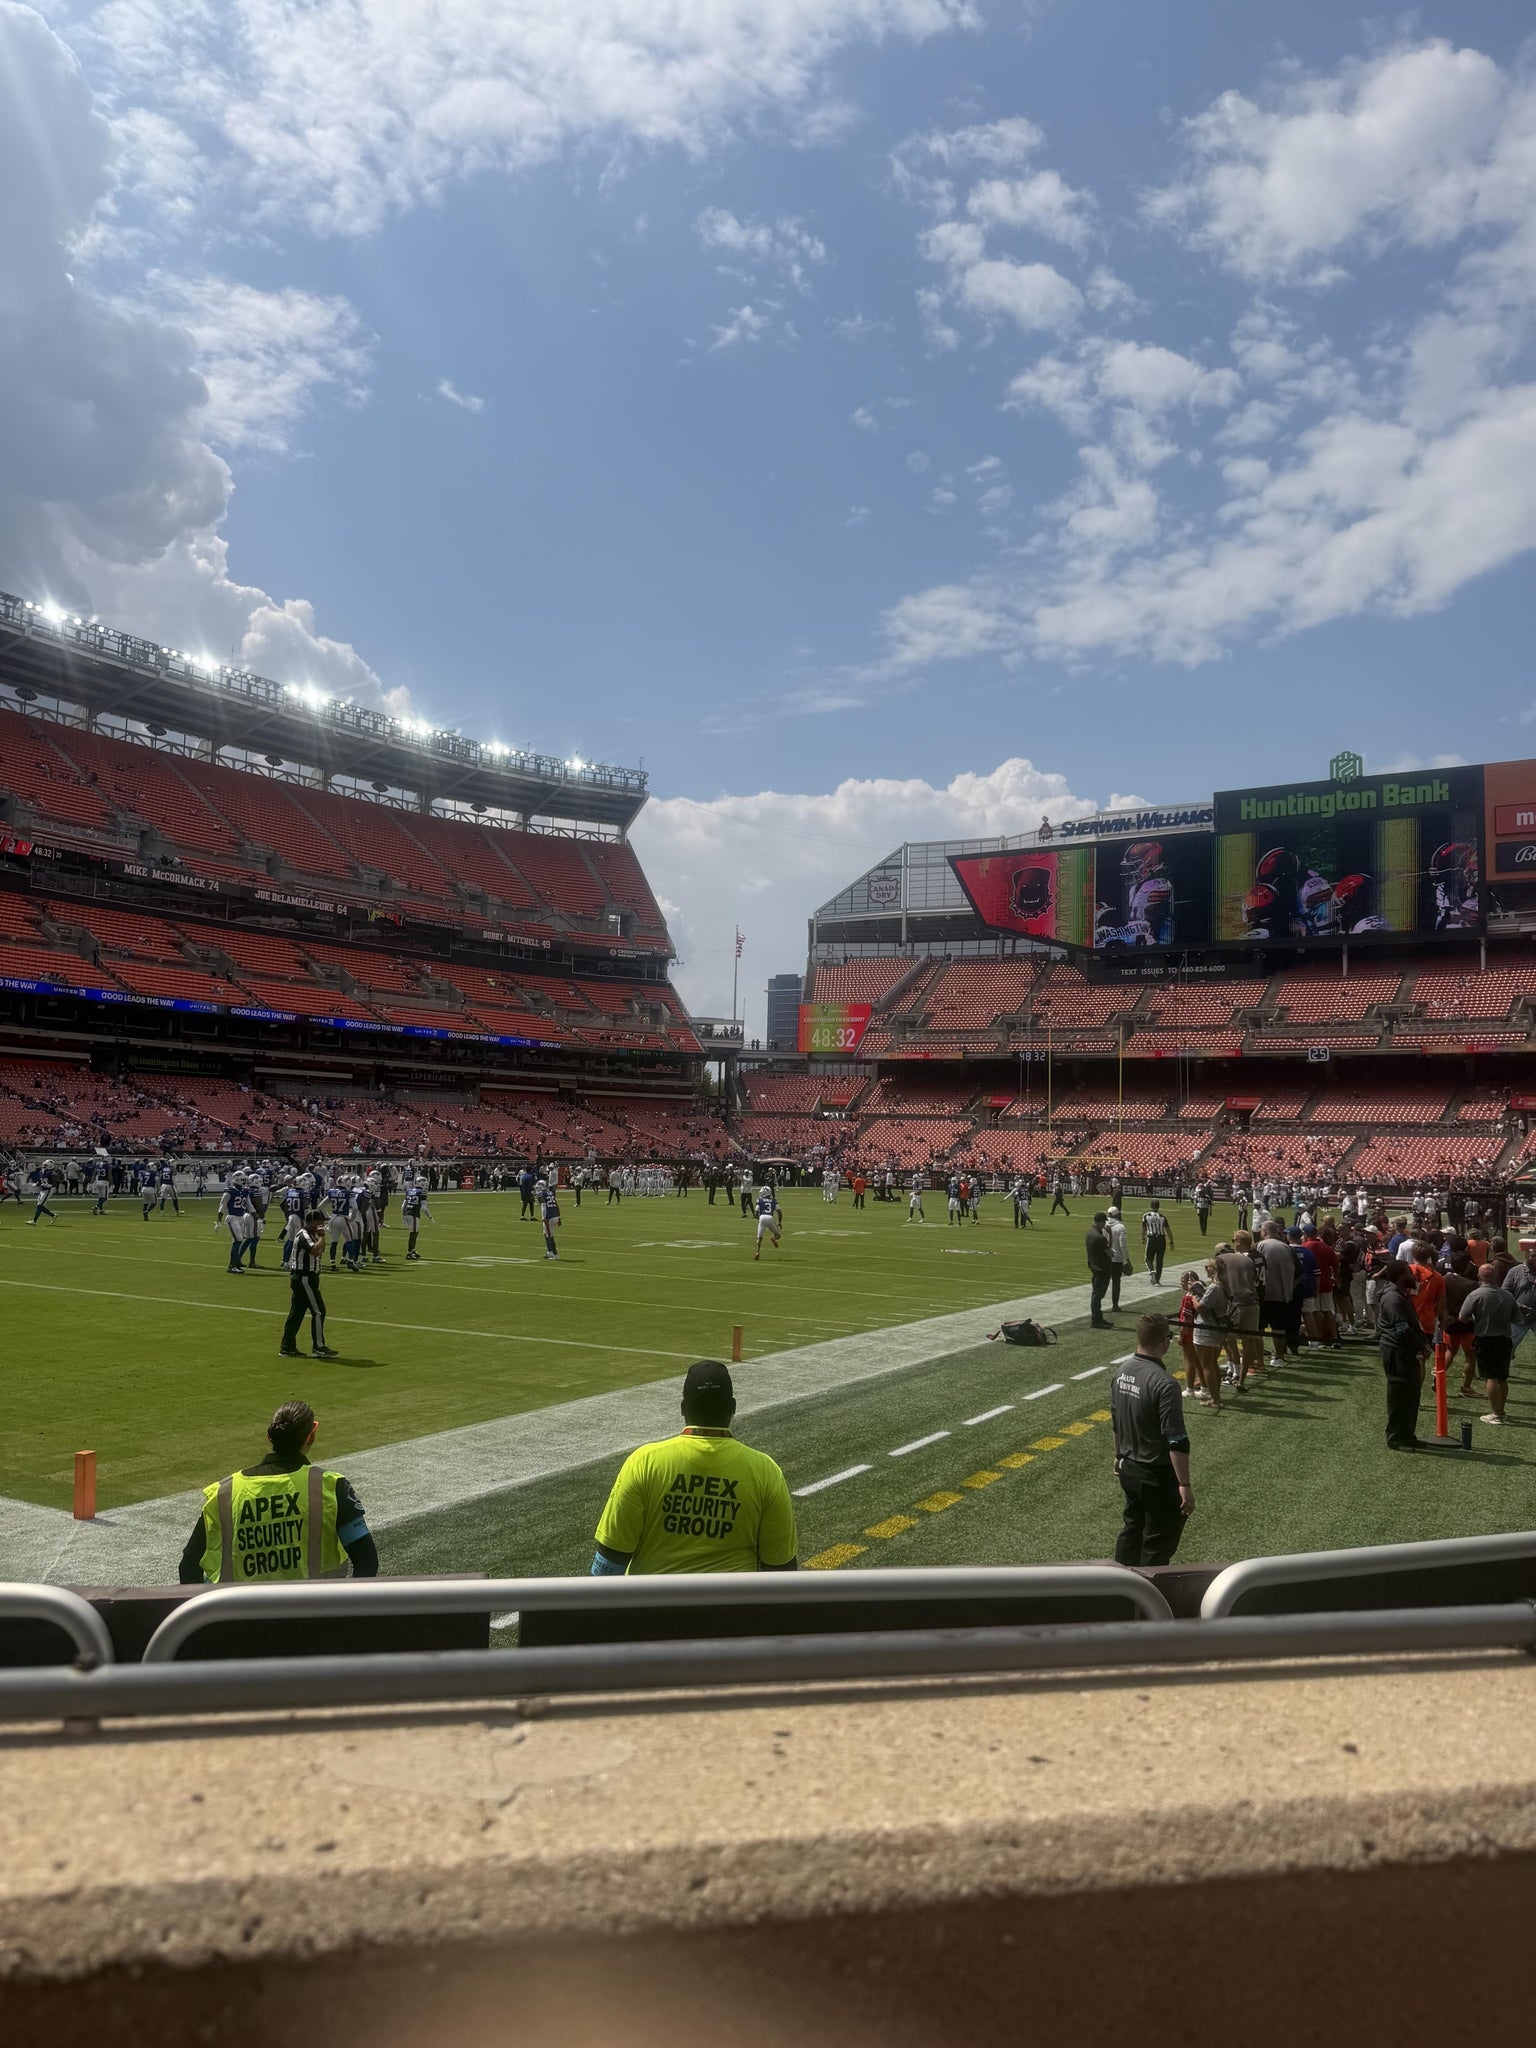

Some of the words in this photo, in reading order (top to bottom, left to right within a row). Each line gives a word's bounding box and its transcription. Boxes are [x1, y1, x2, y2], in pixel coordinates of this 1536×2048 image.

[1240, 789, 1377, 820] Huntington
[1382, 779, 1450, 807] Bank
[1059, 808, 1213, 838] SHERWIN-WILLIAMS
[34, 847, 52, 858] 48:32
[123, 863, 148, 877] MIKE
[207, 880, 220, 891] 74
[254, 890, 270, 901] JOE
[337, 904, 349, 916] 64
[482, 930, 504, 941] BOBBY
[507, 934, 540, 947] MITCHELL
[541, 940, 551, 949] 49
[8, 979, 19, 988] THE
[20, 980, 37, 991] WAY
[54, 986, 79, 995] UNITED
[101, 991, 124, 1001] GOOD
[124, 994, 146, 1004] LEADS
[147, 997, 160, 1006] THE
[160, 998, 175, 1007] WAY
[230, 1008, 251, 1016] GOOD
[251, 1010, 271, 1018] LEADS
[282, 1013, 297, 1021] WAY
[345, 1020, 363, 1028] GOOD
[363, 1022, 381, 1030] LEADS
[381, 1023, 391, 1031] THE
[391, 1024, 404, 1032] WAY
[447, 1031, 463, 1039] GOOD
[463, 1032, 480, 1040] LEADS
[812, 1028, 856, 1048] 48:32
[1311, 1049, 1326, 1059] 25
[410, 1072, 456, 1082] EXPERIENCES
[144, 1175, 150, 1185] 7
[286, 1197, 300, 1211] 30
[330, 1198, 347, 1212] 37
[764, 1202, 772, 1213] 3
[670, 1473, 739, 1499] APEX
[240, 1492, 301, 1524] APEX
[662, 1494, 742, 1520] SECURITY
[237, 1518, 304, 1551] SECURITY
[663, 1515, 734, 1539] GROUP
[243, 1546, 302, 1577] GROUP
